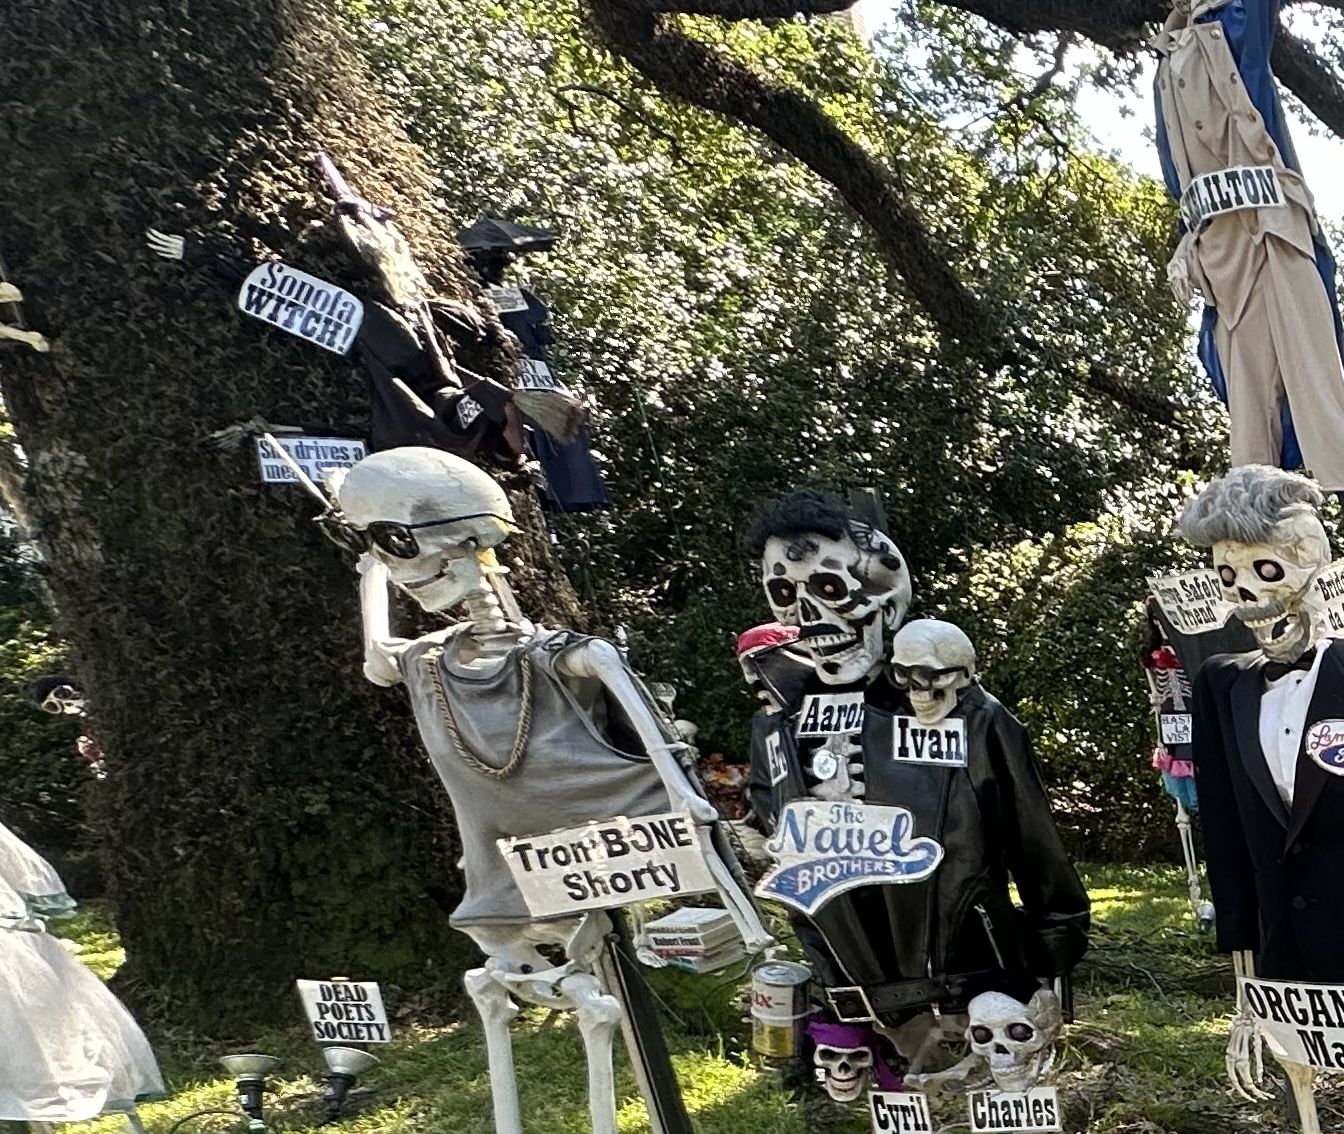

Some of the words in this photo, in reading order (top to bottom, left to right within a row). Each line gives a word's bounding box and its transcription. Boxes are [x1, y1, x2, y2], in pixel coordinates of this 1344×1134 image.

[245, 283, 353, 352] WITCH!
[295, 440, 350, 461] drives
[353, 447, 363, 461] a
[898, 718, 964, 761] Ivan
[830, 803, 865, 825] The
[769, 808, 912, 857] Navel
[562, 860, 681, 901] Shorty
[319, 983, 369, 1002] DEAD
[316, 1002, 376, 1022] POETS
[313, 1020, 386, 1041] SOCIETY
[972, 1091, 1056, 1130] Charles
